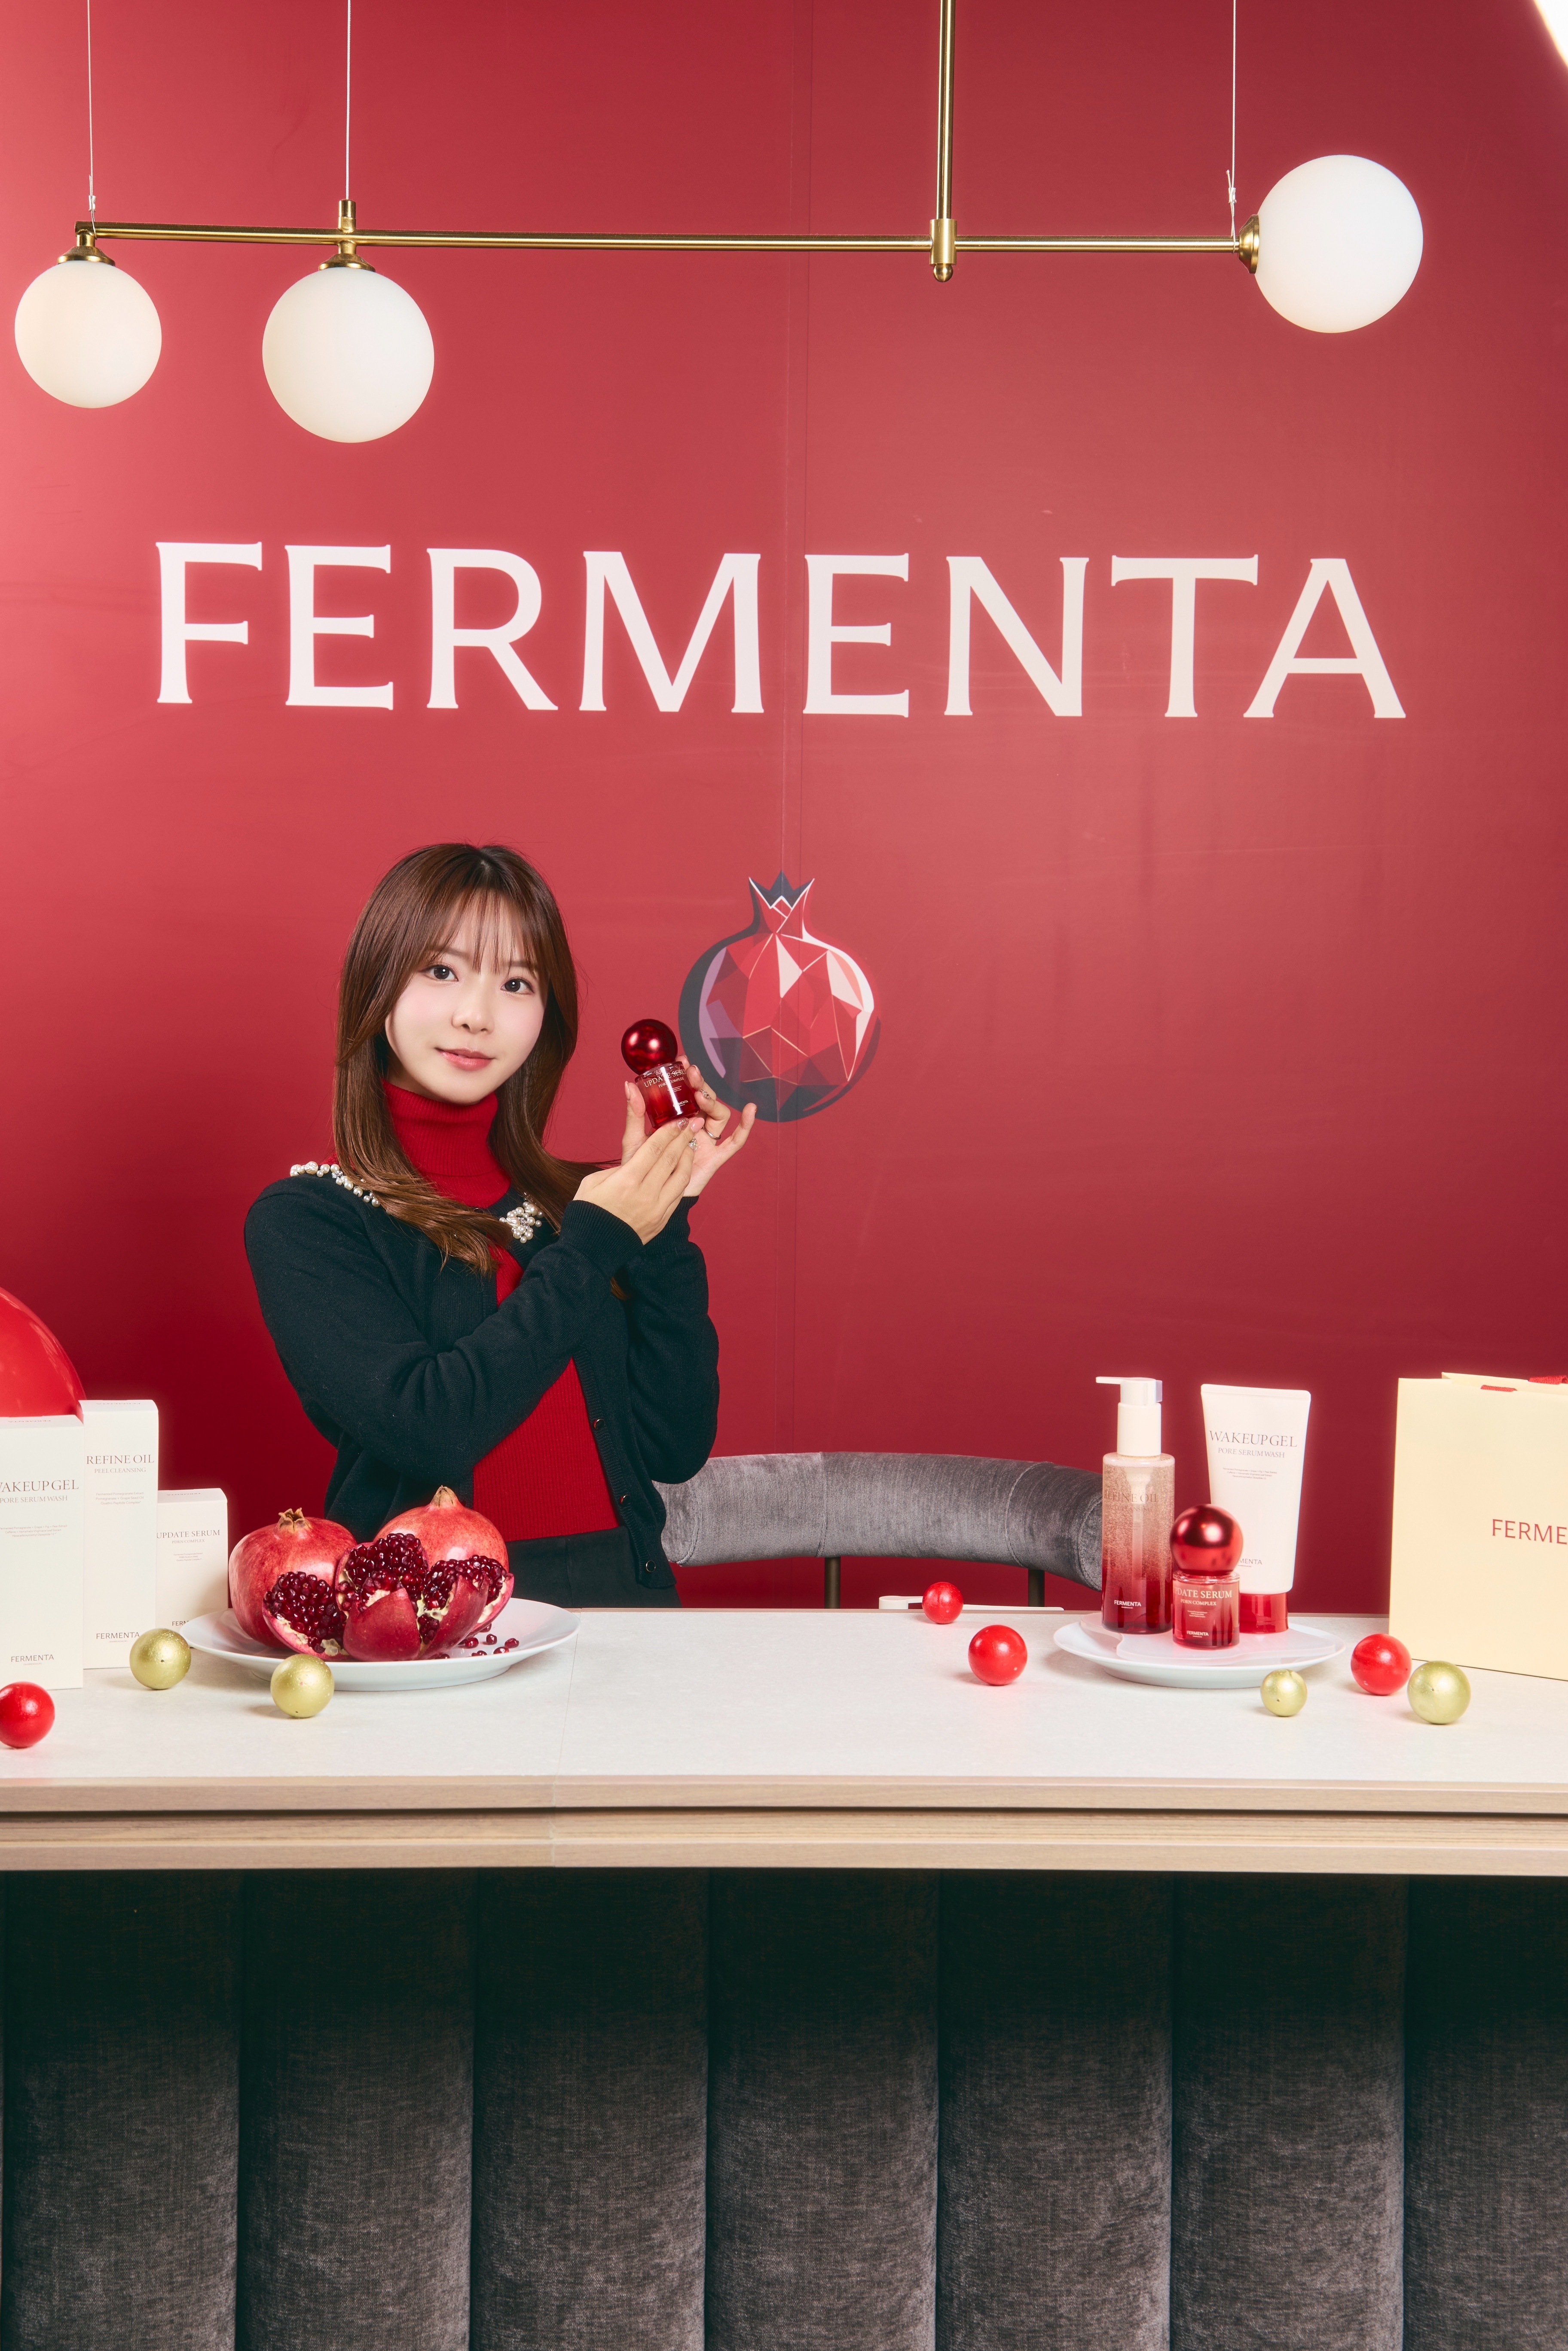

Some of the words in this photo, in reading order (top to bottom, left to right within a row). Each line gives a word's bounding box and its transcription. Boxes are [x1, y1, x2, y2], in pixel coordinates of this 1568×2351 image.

[156, 541, 1405, 718] FERMENTA
[644, 1073, 672, 1087] UPDAE
[86, 1455, 131, 1464] REFINE
[133, 1454, 154, 1464] OIL
[52, 1480, 79, 1490] GEL
[1140, 1493, 1159, 1502] OIL
[1492, 1519, 1568, 1545] FERME
[1175, 1587, 1198, 1598] PDATE
[1201, 1590, 1232, 1599] SERUM
